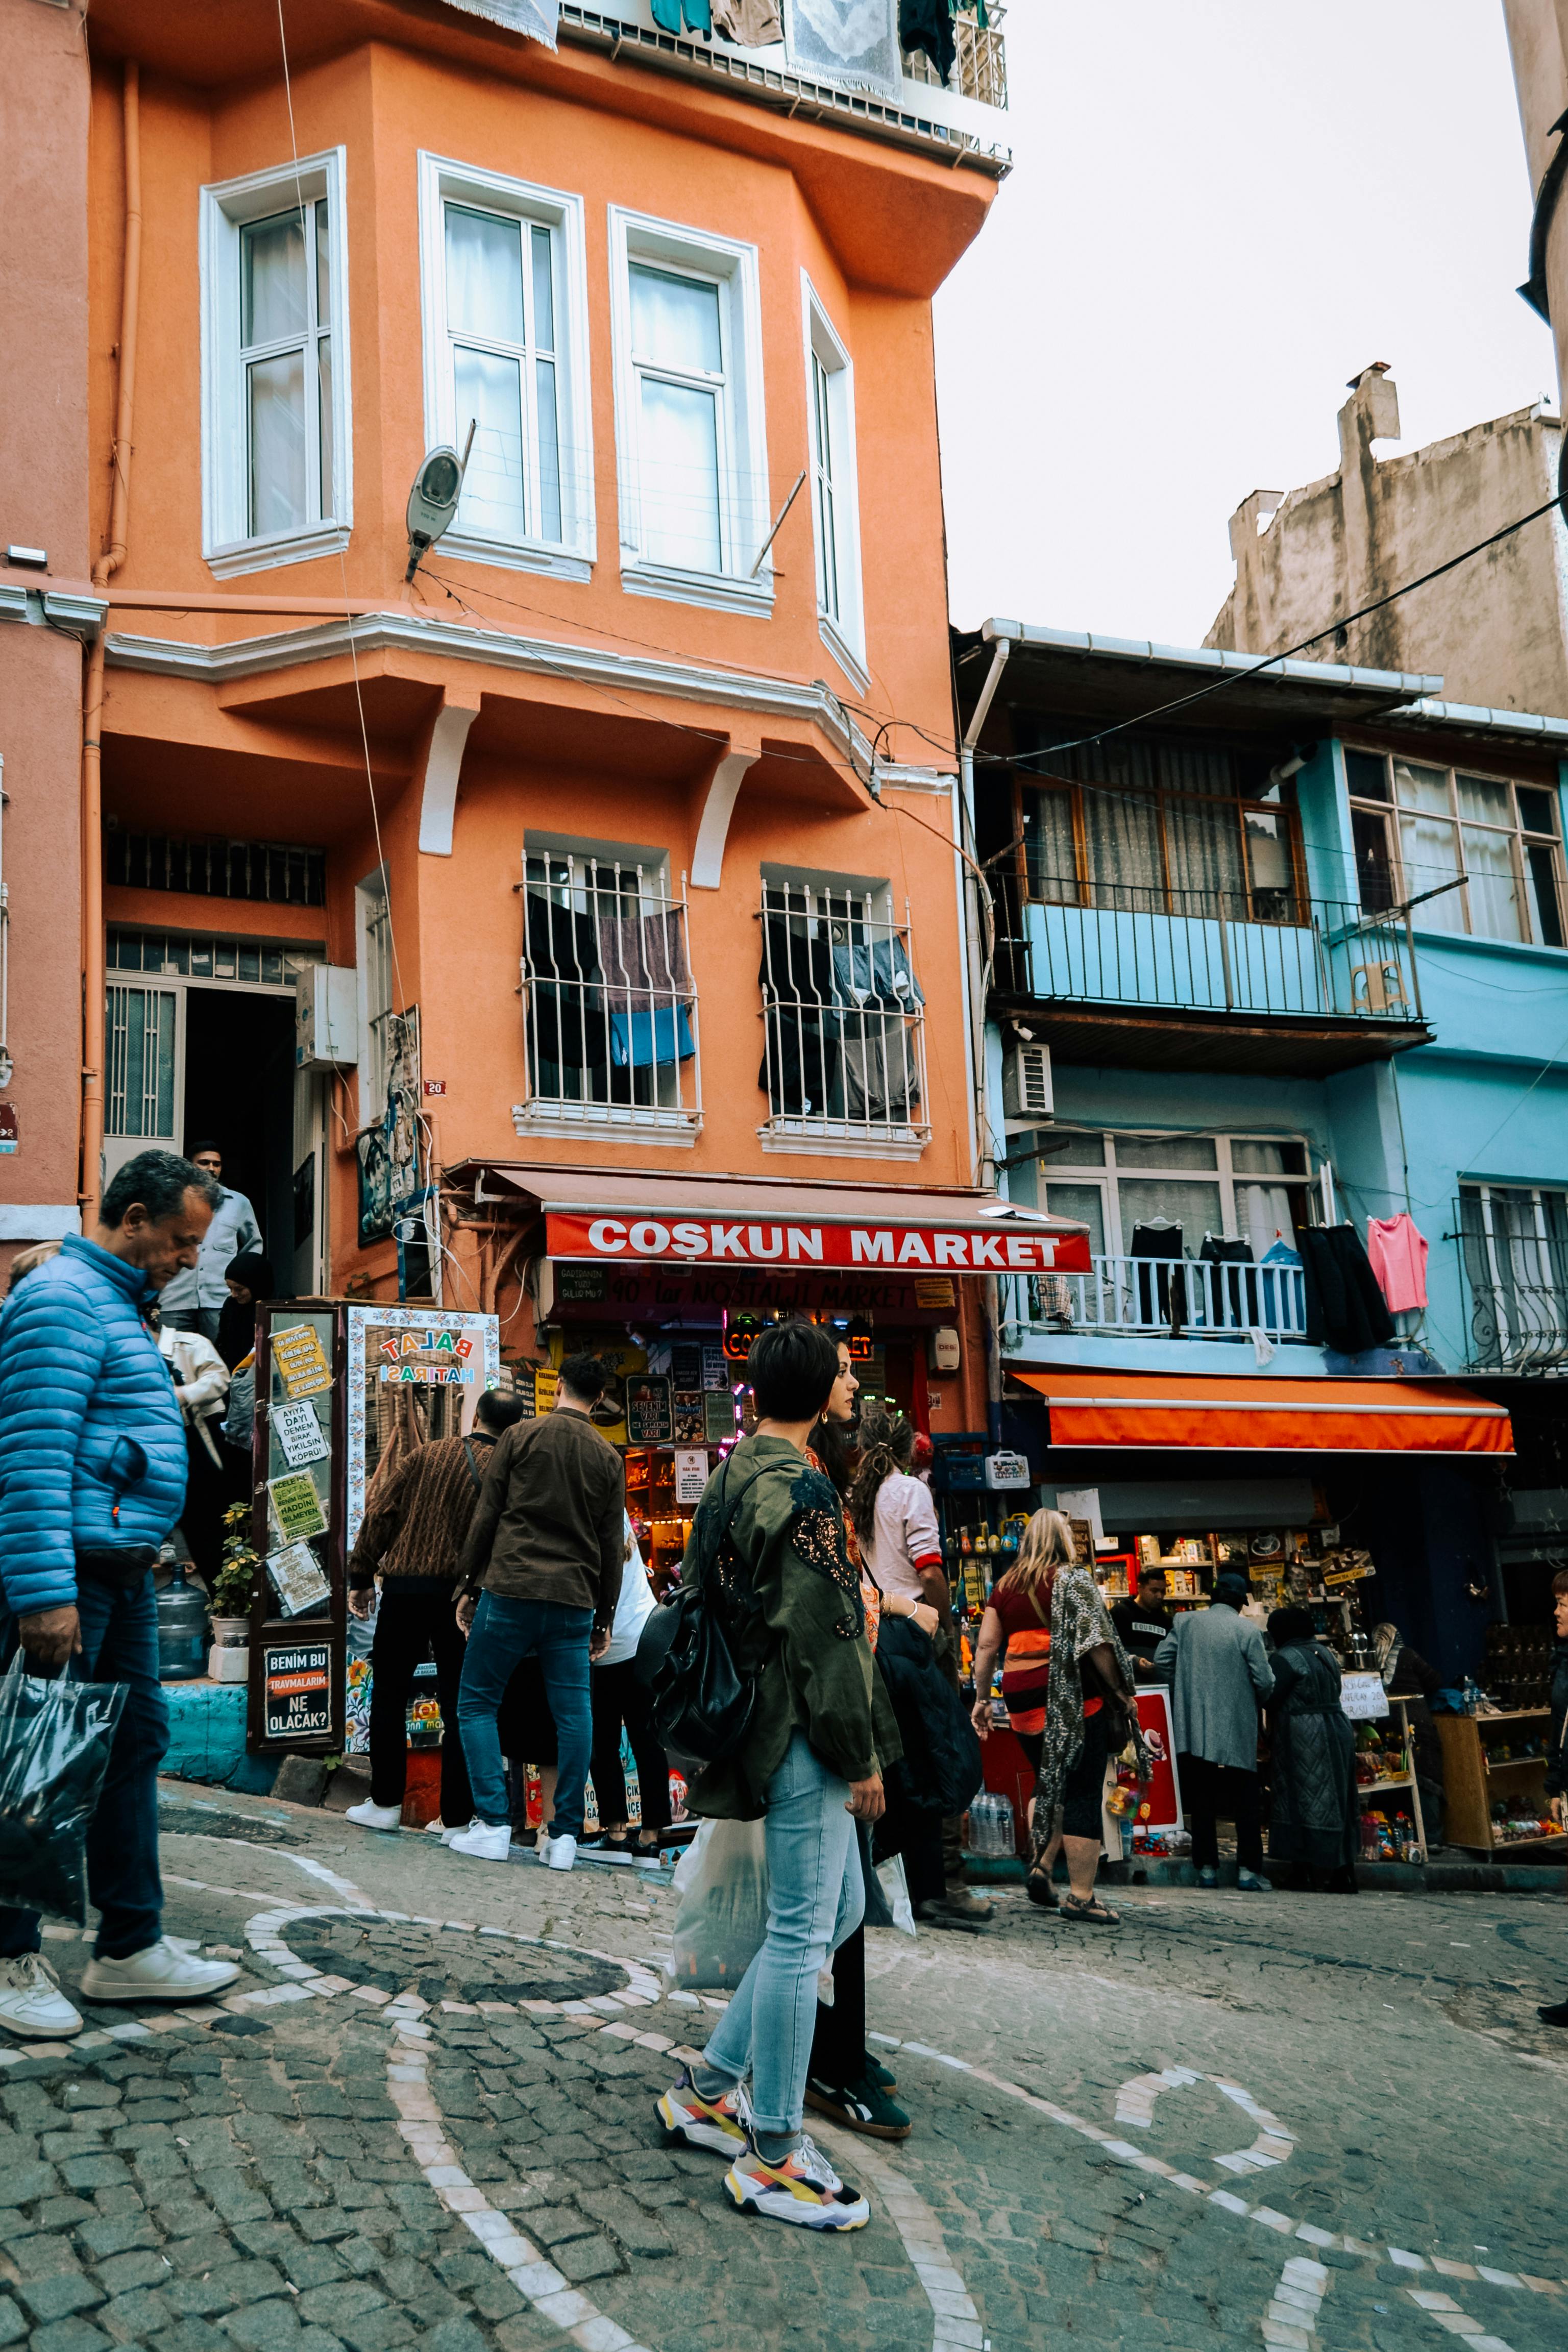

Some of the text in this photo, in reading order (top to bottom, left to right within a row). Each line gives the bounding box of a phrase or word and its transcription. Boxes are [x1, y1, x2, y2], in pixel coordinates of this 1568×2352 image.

[429, 1083, 442, 1093] 20
[588, 1219, 1060, 1267] COŞKUN MARKET
[820, 1283, 912, 1308] MARKET
[283, 1406, 305, 1418] AYIYA
[285, 1414, 307, 1427] DAYI
[284, 1422, 314, 1436] DEMEM
[290, 1431, 311, 1443] BIRAK
[286, 1437, 321, 1453] YIKILSIN
[291, 1447, 322, 1463] KÖPRÜ!
[273, 1477, 296, 1490] ACELE
[275, 1482, 310, 1500] ŞEYTAN
[277, 1496, 297, 1507] BENİM
[281, 1497, 314, 1515] HADDİNİ
[282, 1507, 318, 1524] BİLMEYEN
[270, 1652, 326, 1671] BENİM BU
[271, 1676, 326, 1690] TRAVMALARIM
[289, 1696, 308, 1713] NE
[270, 1711, 327, 1731] OLACAK?
[585, 1785, 640, 1802] YO ÇIK
